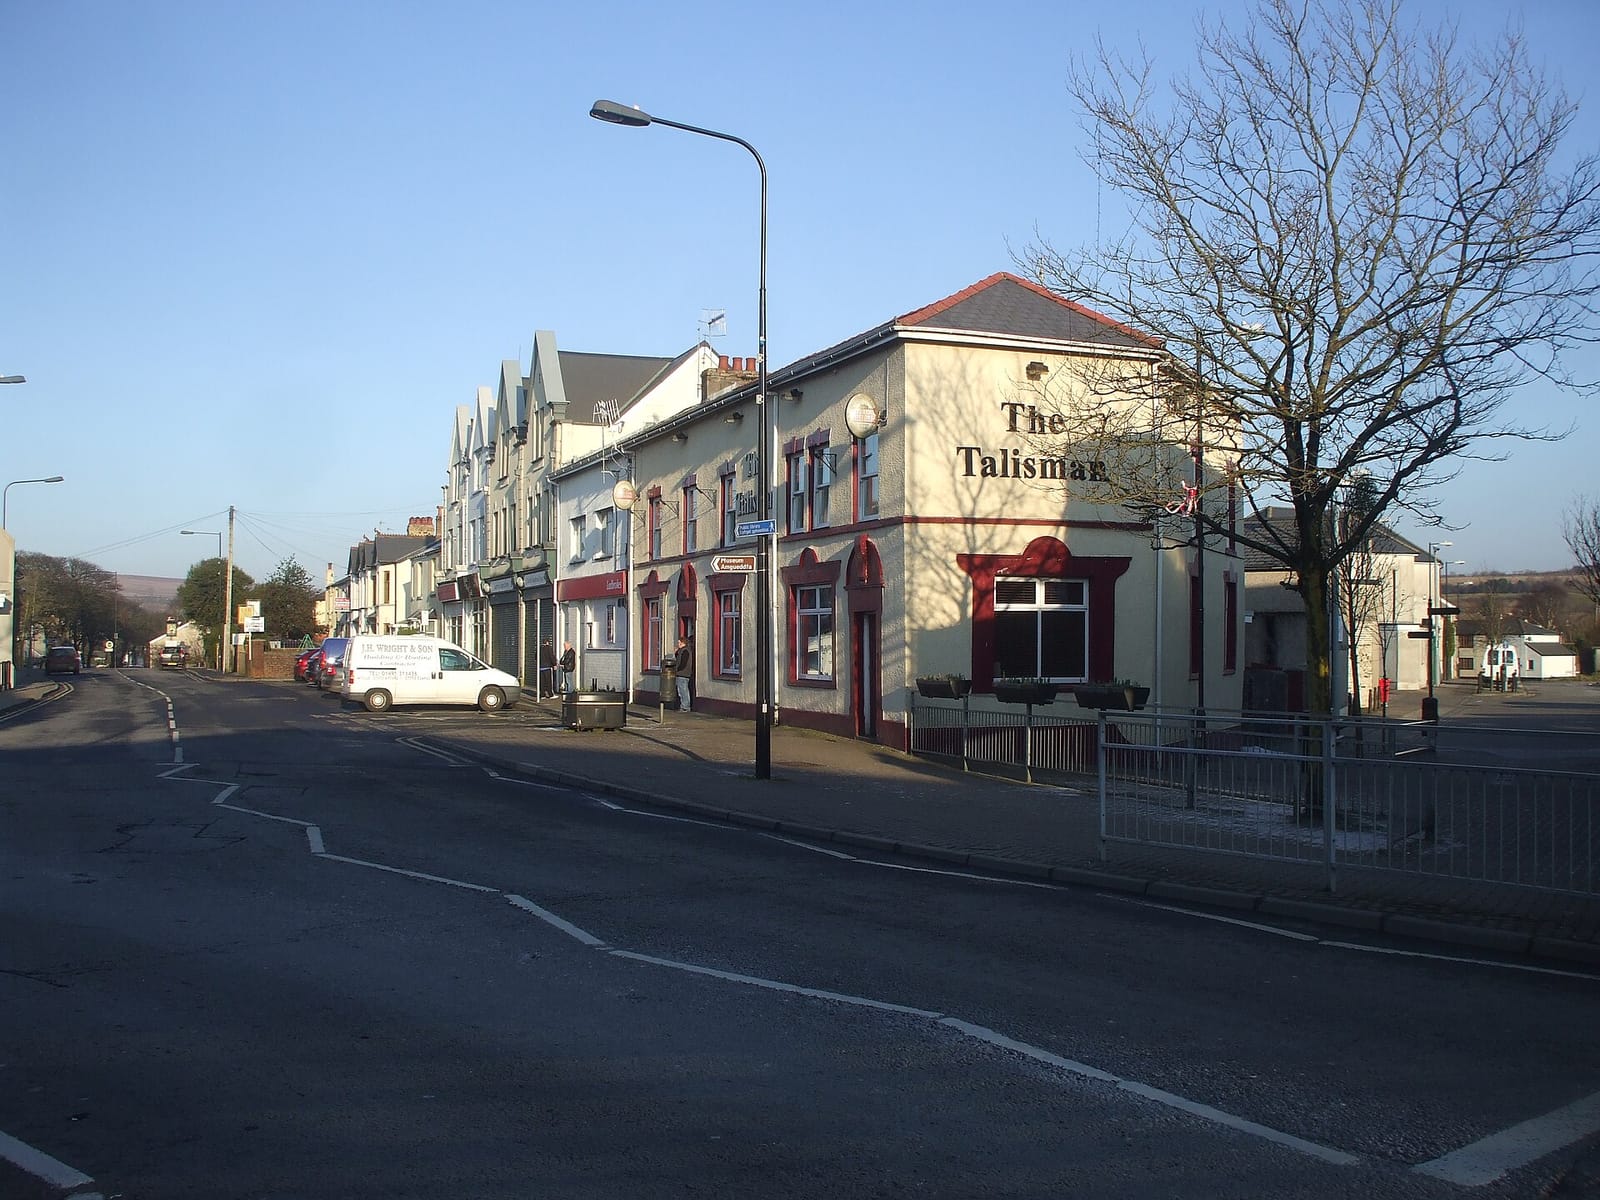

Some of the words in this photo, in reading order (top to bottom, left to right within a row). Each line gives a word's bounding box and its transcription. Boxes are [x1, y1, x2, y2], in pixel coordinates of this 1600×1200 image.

[1001, 402, 1065, 435] The
[746, 452, 759, 477] Th
[956, 447, 1109, 482] Talisman
[376, 644, 408, 653] WRIGHT
[410, 645, 416, 653] &
[418, 645, 433, 653] SON
